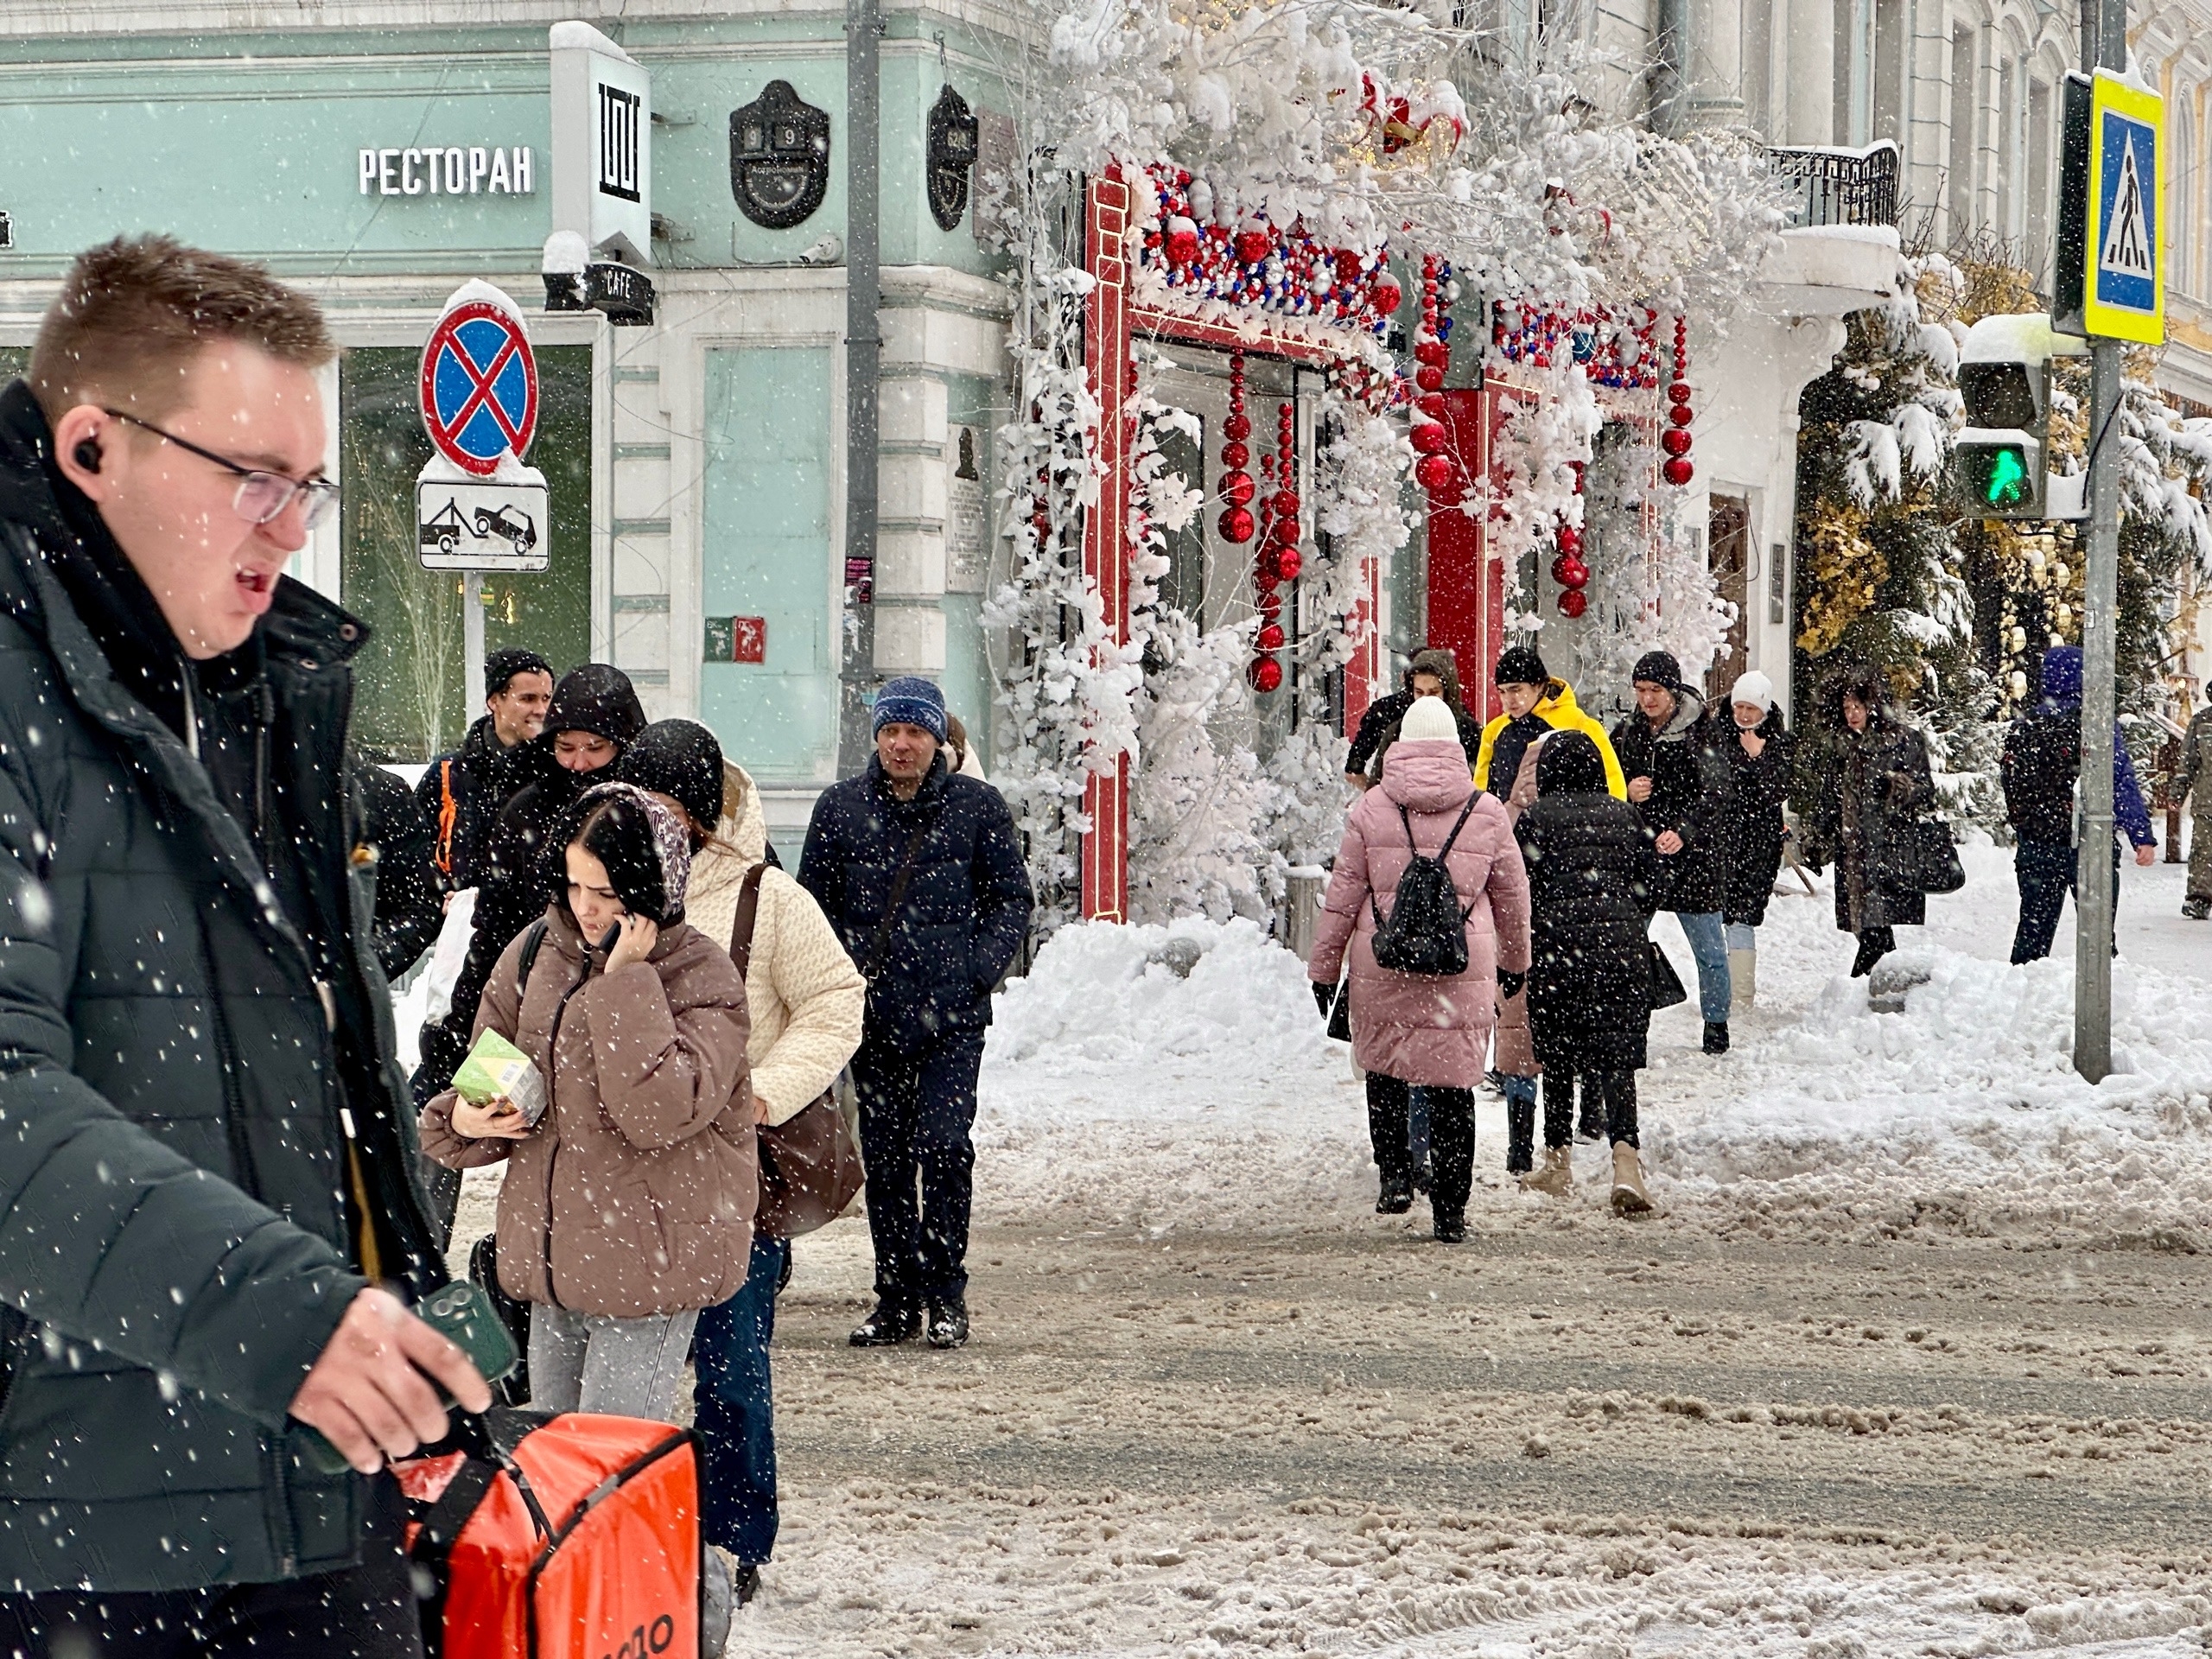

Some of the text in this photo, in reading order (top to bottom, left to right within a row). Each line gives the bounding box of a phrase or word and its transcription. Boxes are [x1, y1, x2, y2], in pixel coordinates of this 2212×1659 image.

[785, 129, 796, 145] 9
[359, 146, 532, 195] РЕСТОРАН
[607, 269, 632, 299] CAFE
